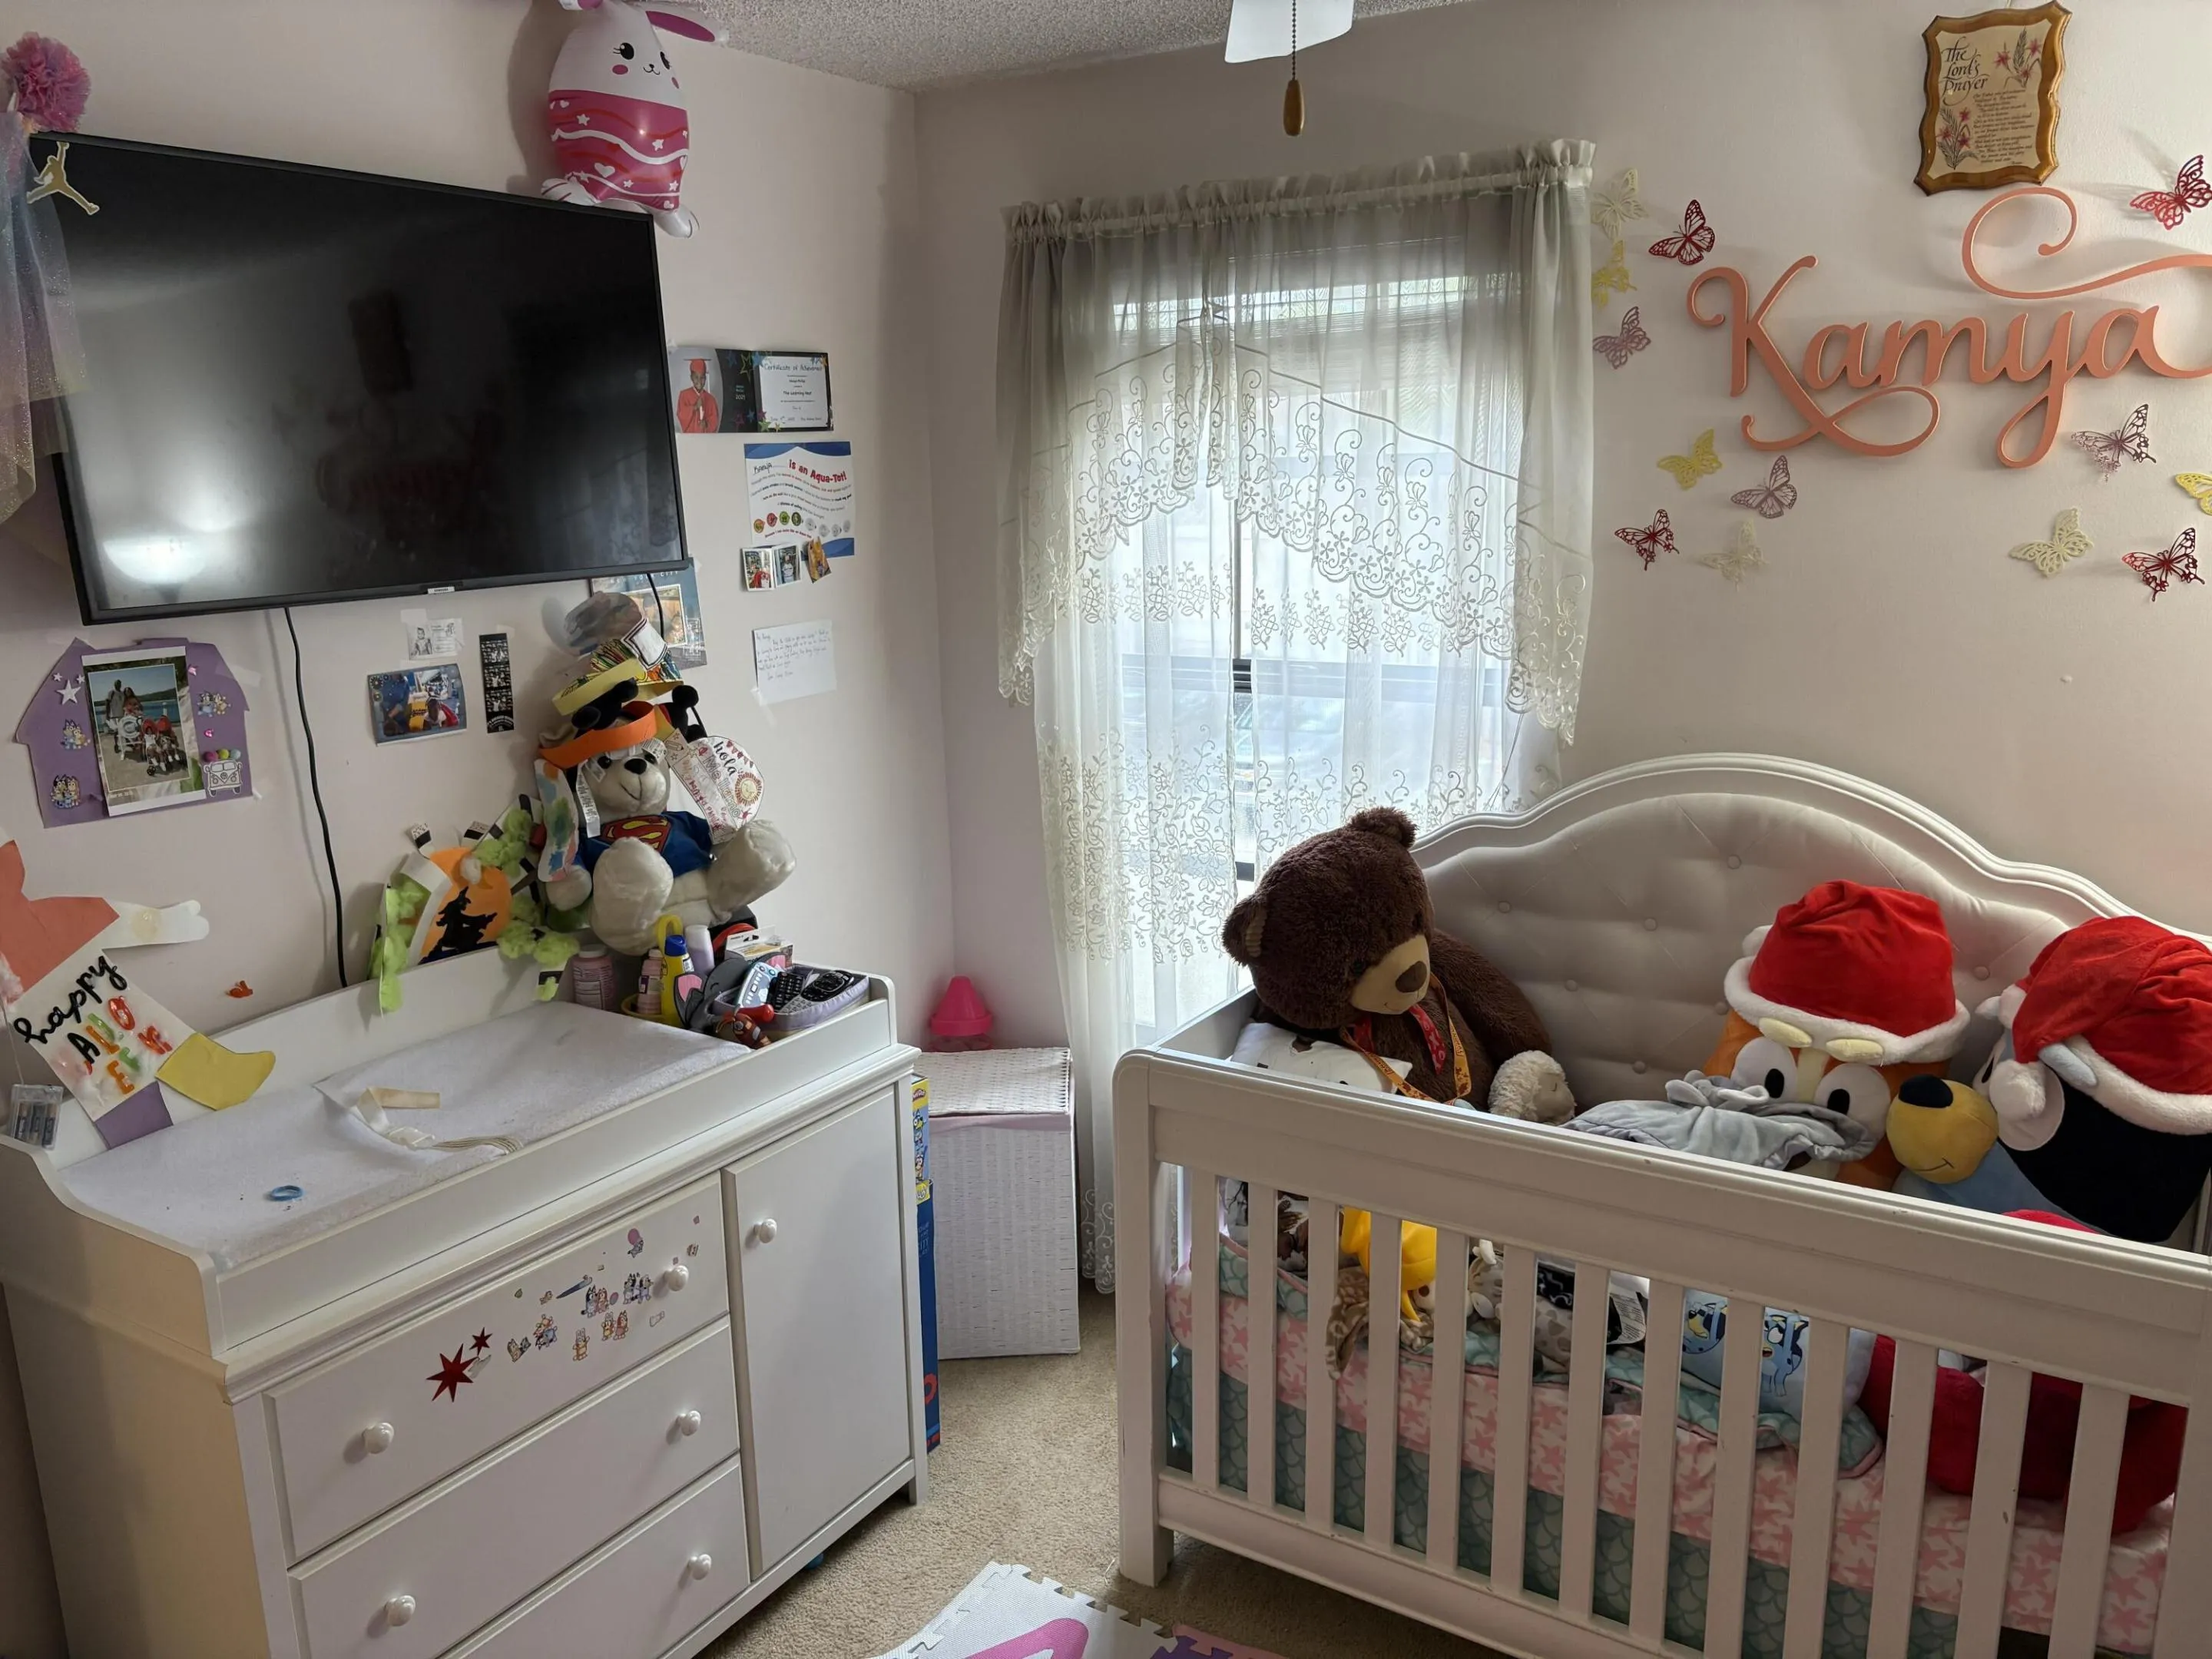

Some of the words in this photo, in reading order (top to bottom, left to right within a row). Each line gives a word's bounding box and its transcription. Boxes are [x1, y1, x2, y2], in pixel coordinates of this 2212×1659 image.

[1941, 36, 1972, 62] The
[1942, 51, 1980, 81] Lord's
[1939, 75, 1990, 106] Prayer
[1687, 187, 2212, 468] Kamya
[789, 459, 796, 469] Is
[799, 465, 808, 475] an
[703, 755, 721, 780] Me
[714, 741, 737, 777] hola
[13, 955, 128, 1045] happy
